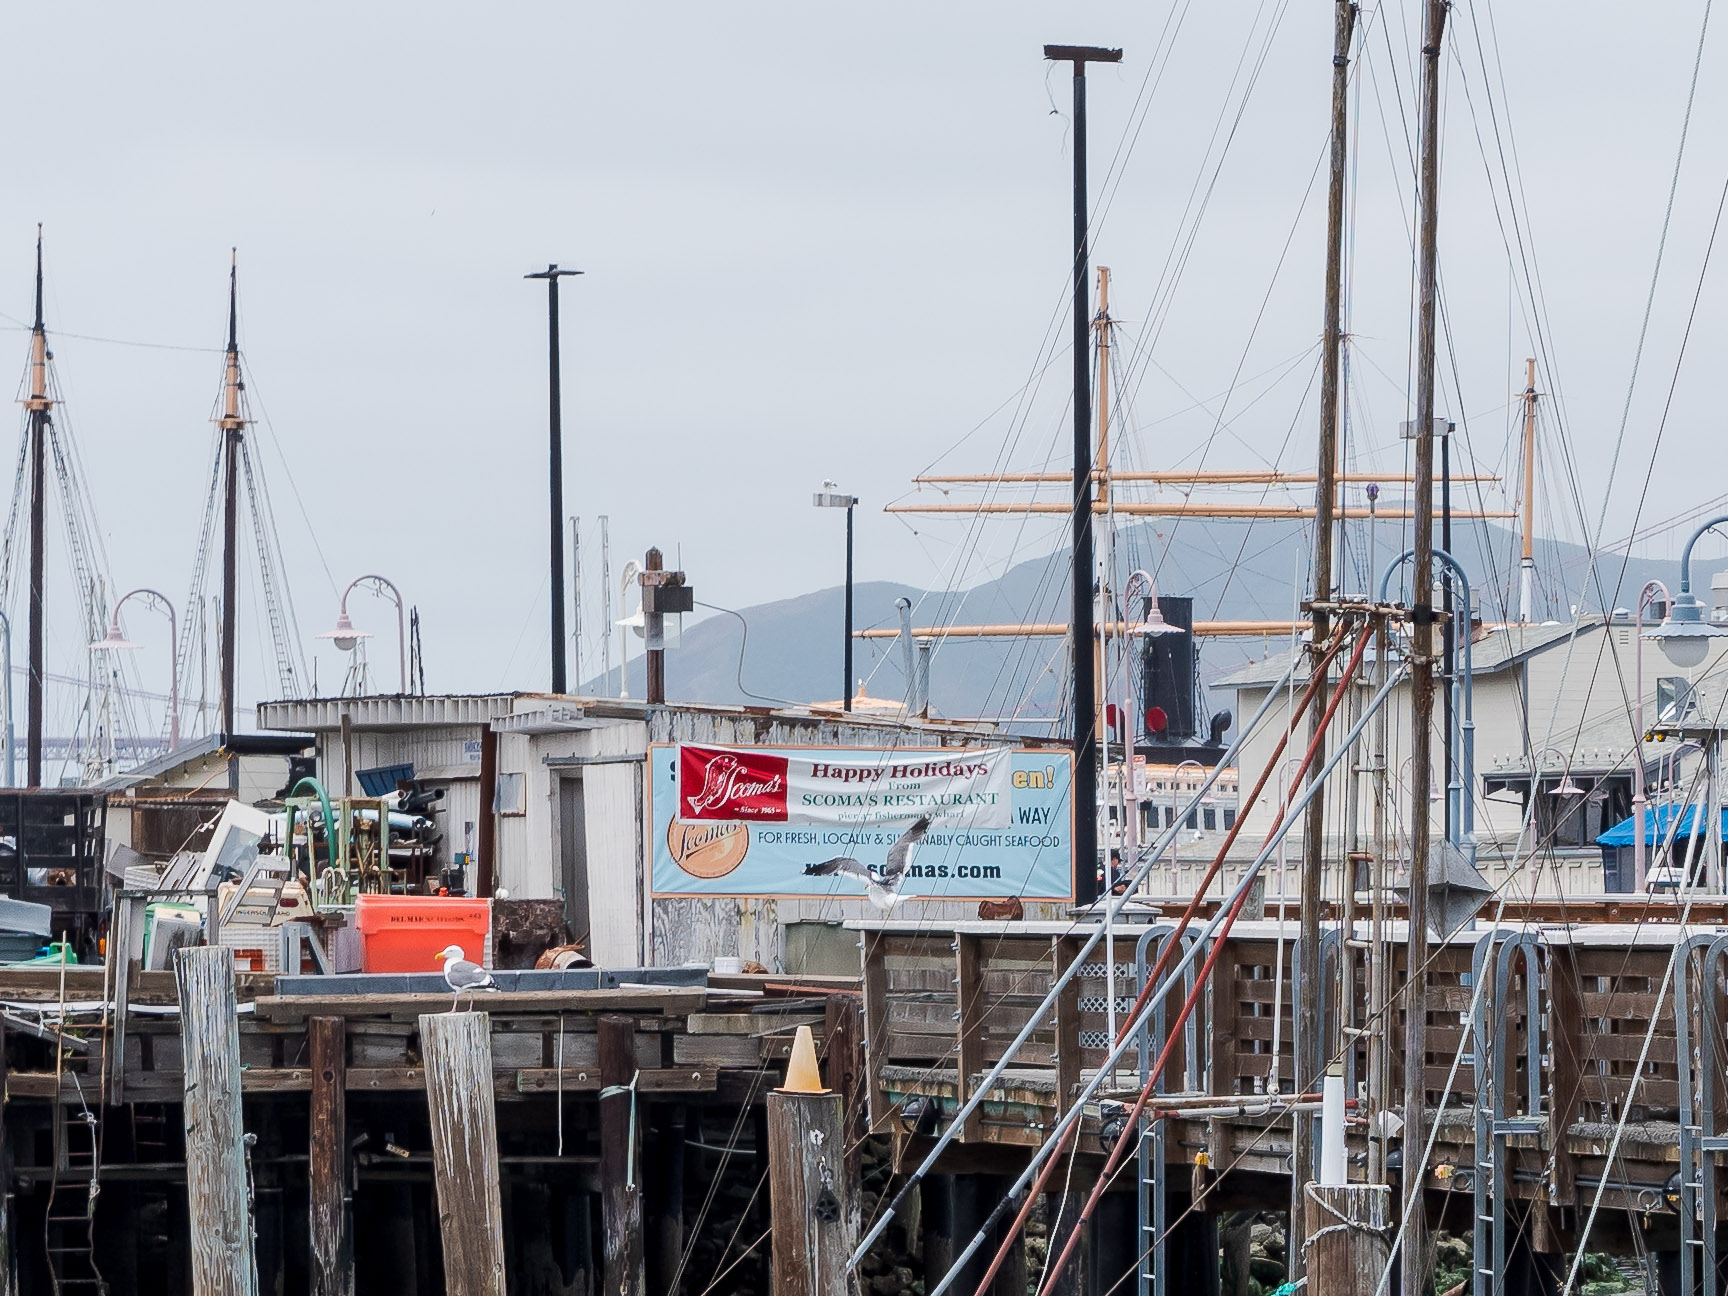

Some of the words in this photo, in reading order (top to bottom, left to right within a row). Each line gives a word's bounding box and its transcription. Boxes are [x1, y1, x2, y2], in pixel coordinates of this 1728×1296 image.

[811, 764, 885, 783] Happy
[891, 761, 988, 781] Holidays
[889, 782, 921, 790] From
[802, 793, 877, 807] SCOMA'S
[883, 793, 999, 806] RESTAURANT
[1019, 807, 1051, 824] WAY
[758, 831, 783, 844] FOR
[785, 831, 820, 846] FRESH,
[823, 832, 872, 846] LOCALLY
[874, 834, 884, 845] &
[955, 834, 1003, 847] CAUGHT
[1005, 835, 1060, 848] SEAFOOD
